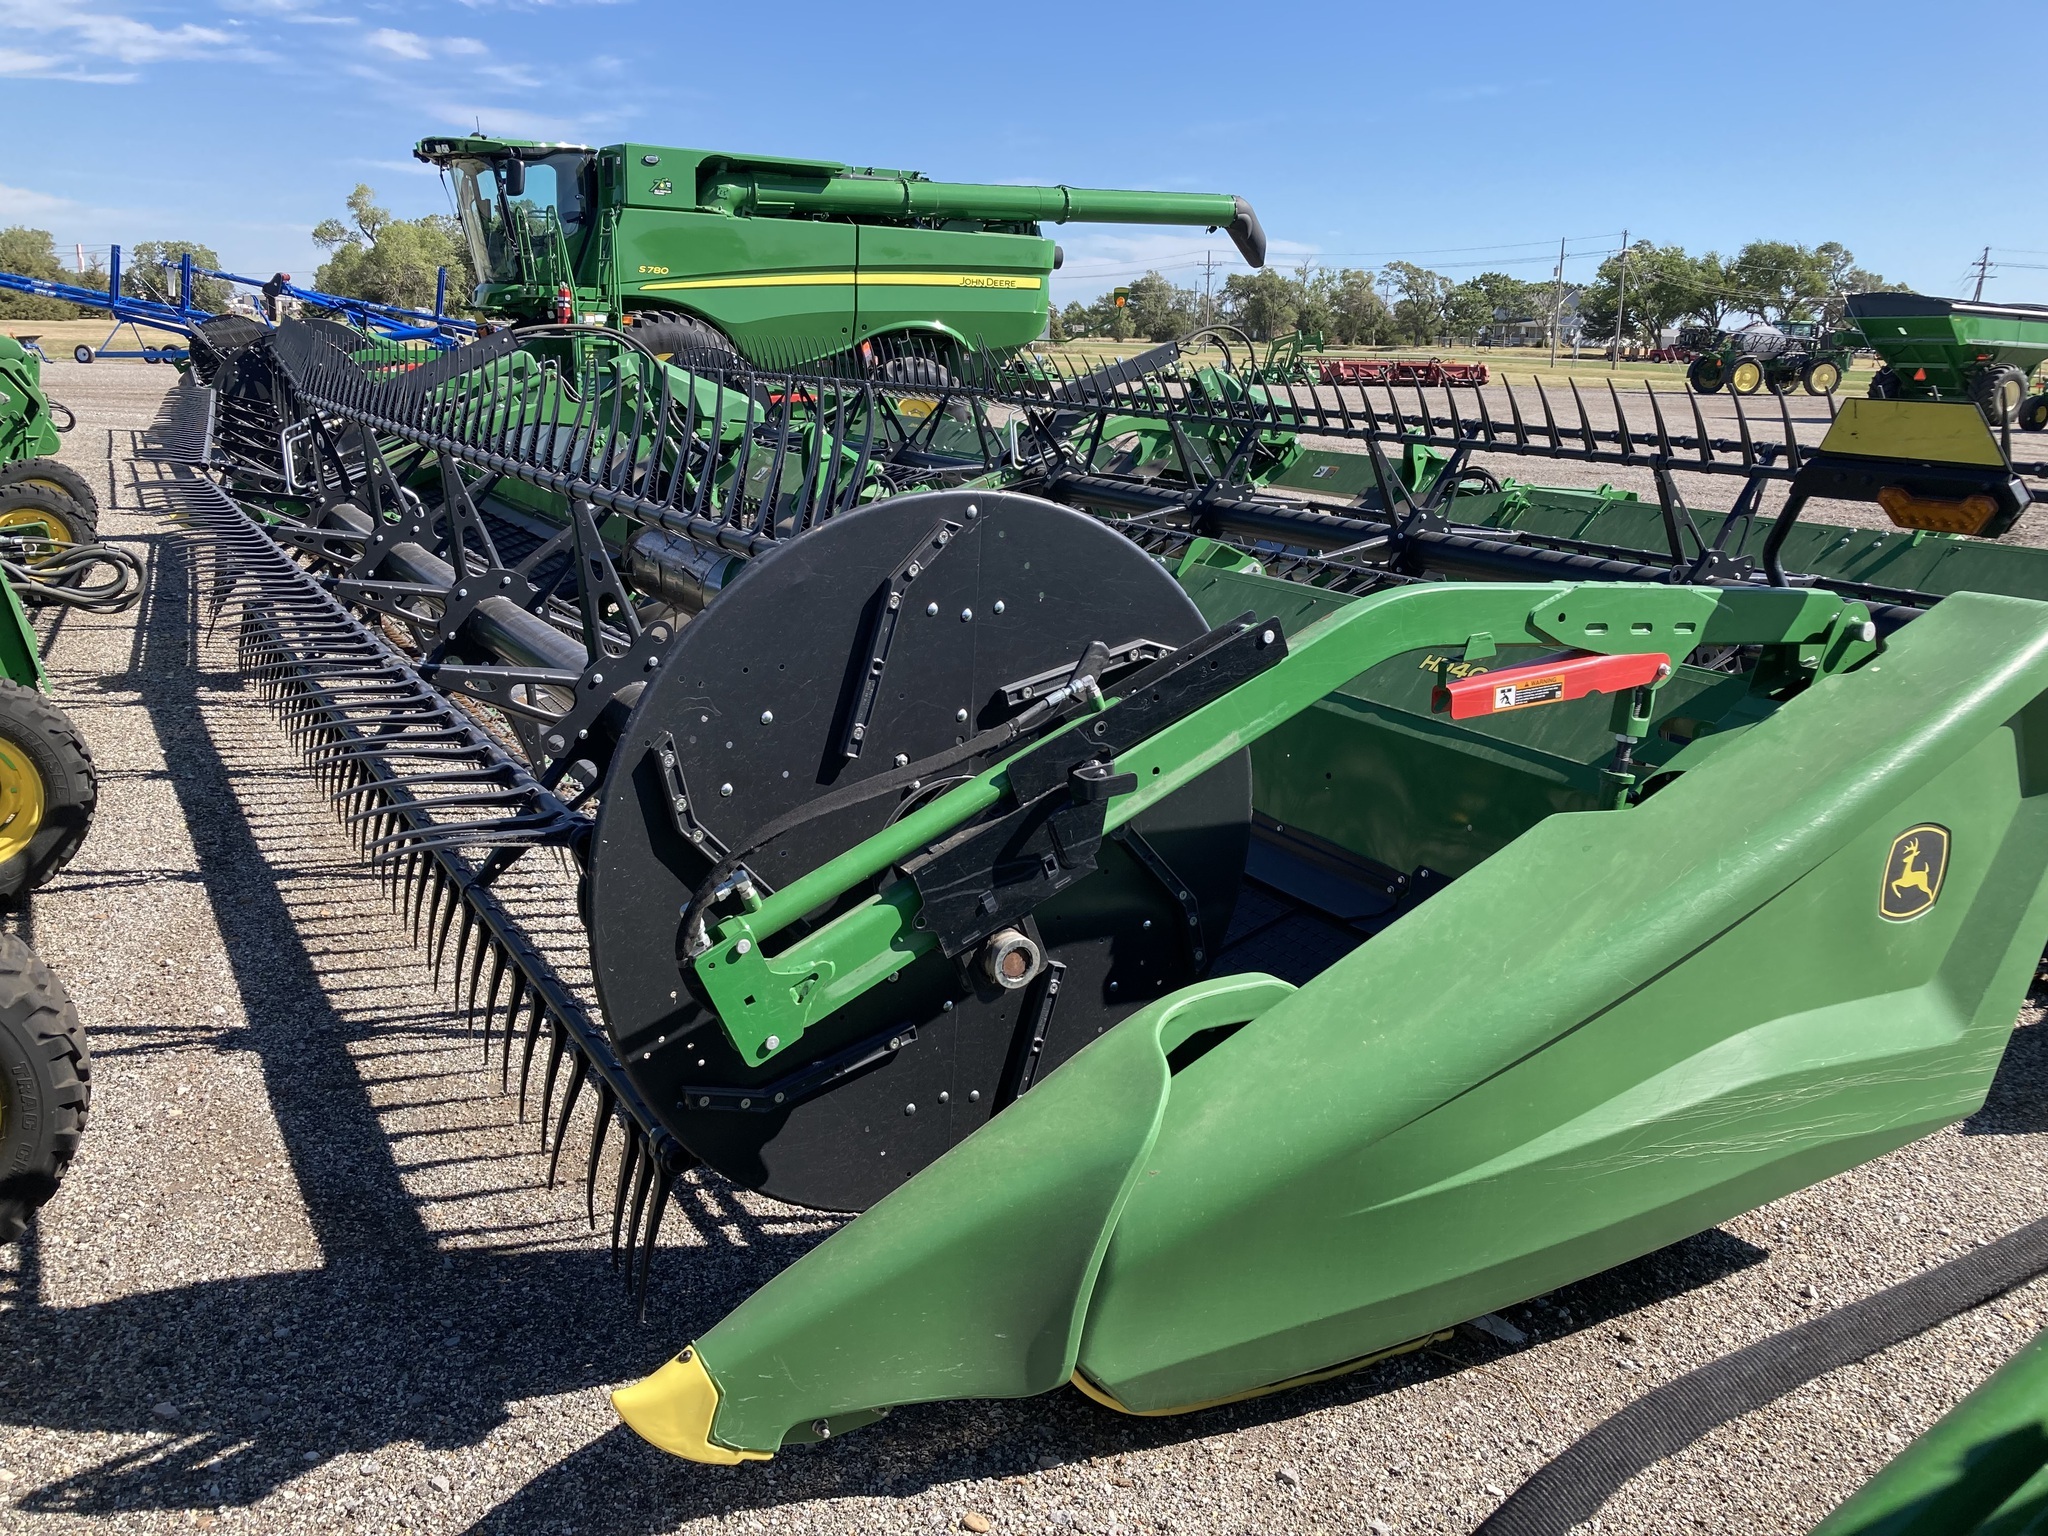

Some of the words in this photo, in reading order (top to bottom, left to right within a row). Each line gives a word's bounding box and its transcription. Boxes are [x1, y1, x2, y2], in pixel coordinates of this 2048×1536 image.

[959, 276, 985, 287] JOHN
[986, 277, 1017, 288] DEERE
[1530, 676, 1557, 686] WARNING
[12, 1061, 38, 1131] TRAC
